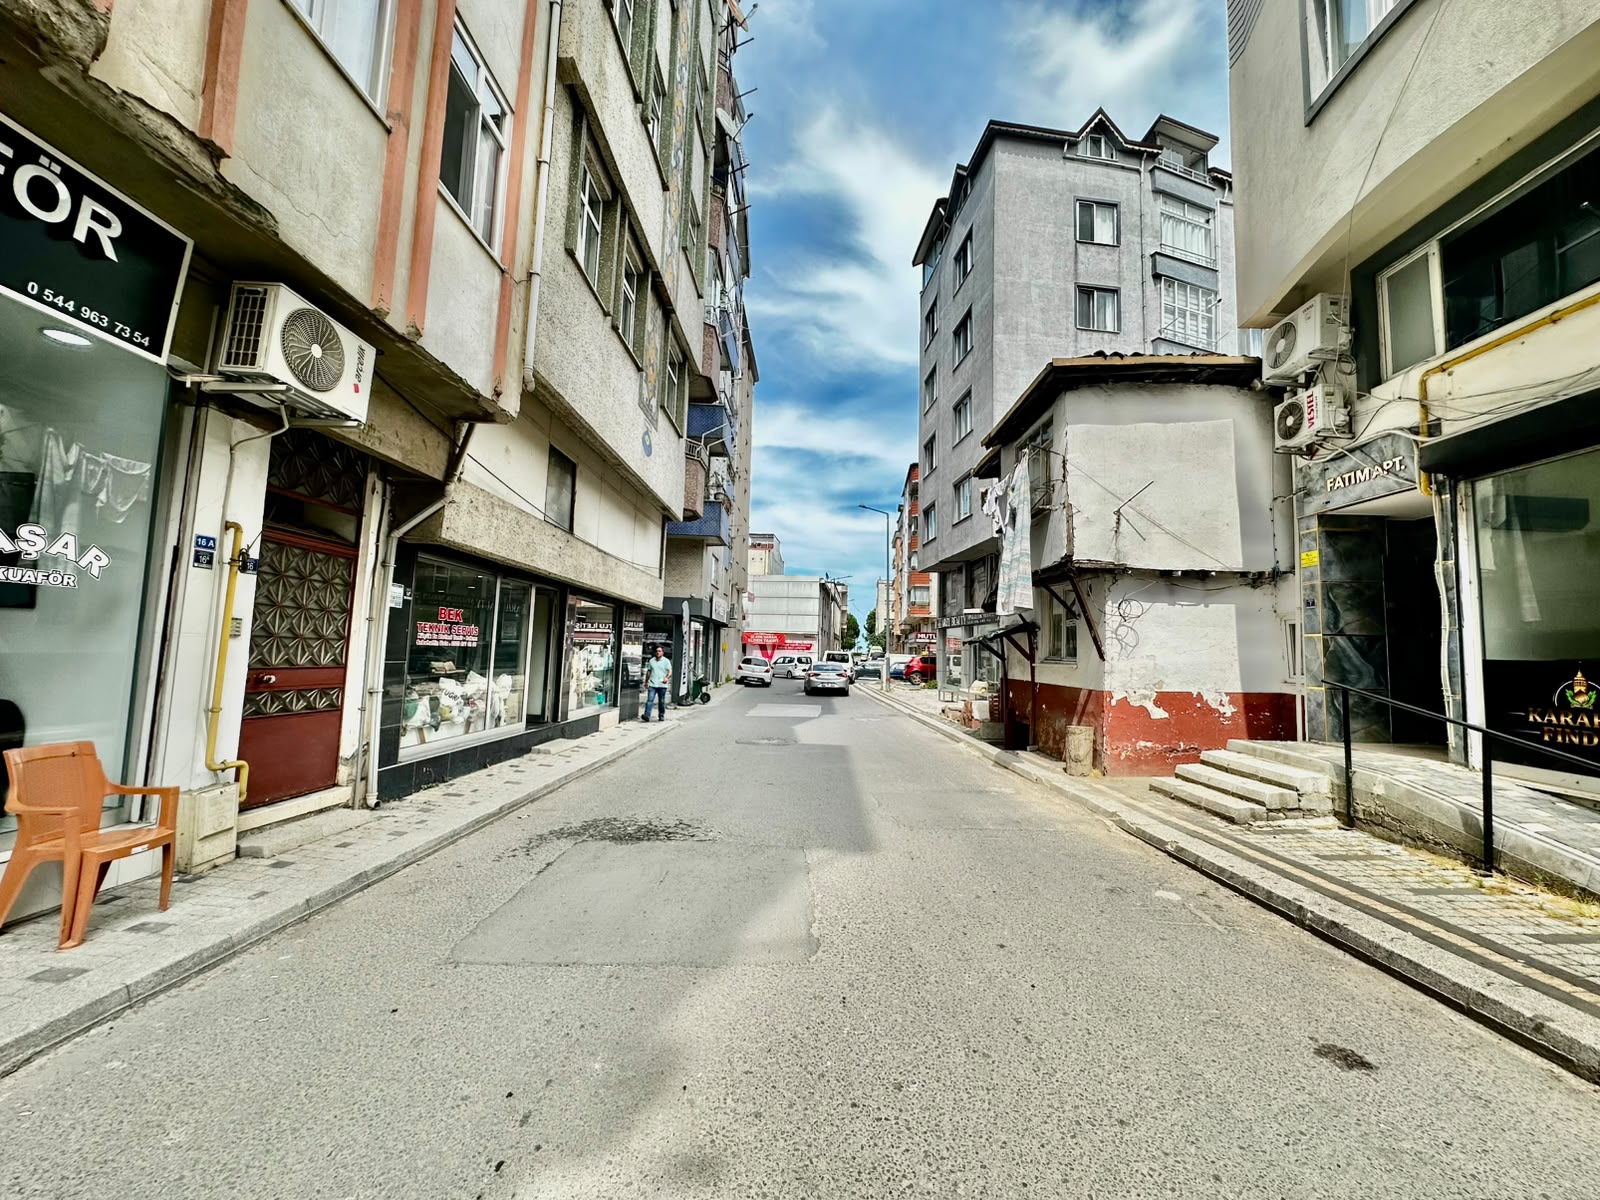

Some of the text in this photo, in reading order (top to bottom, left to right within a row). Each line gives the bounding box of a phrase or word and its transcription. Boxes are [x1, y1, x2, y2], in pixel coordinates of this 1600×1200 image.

[27, 281, 150, 347] 0 544 963 73 54
[1306, 391, 1315, 429] VESTEL
[197, 538, 215, 548] 16 A
[438, 607, 464, 622] BEK
[417, 621, 479, 636] TEKNİK SERVİS
